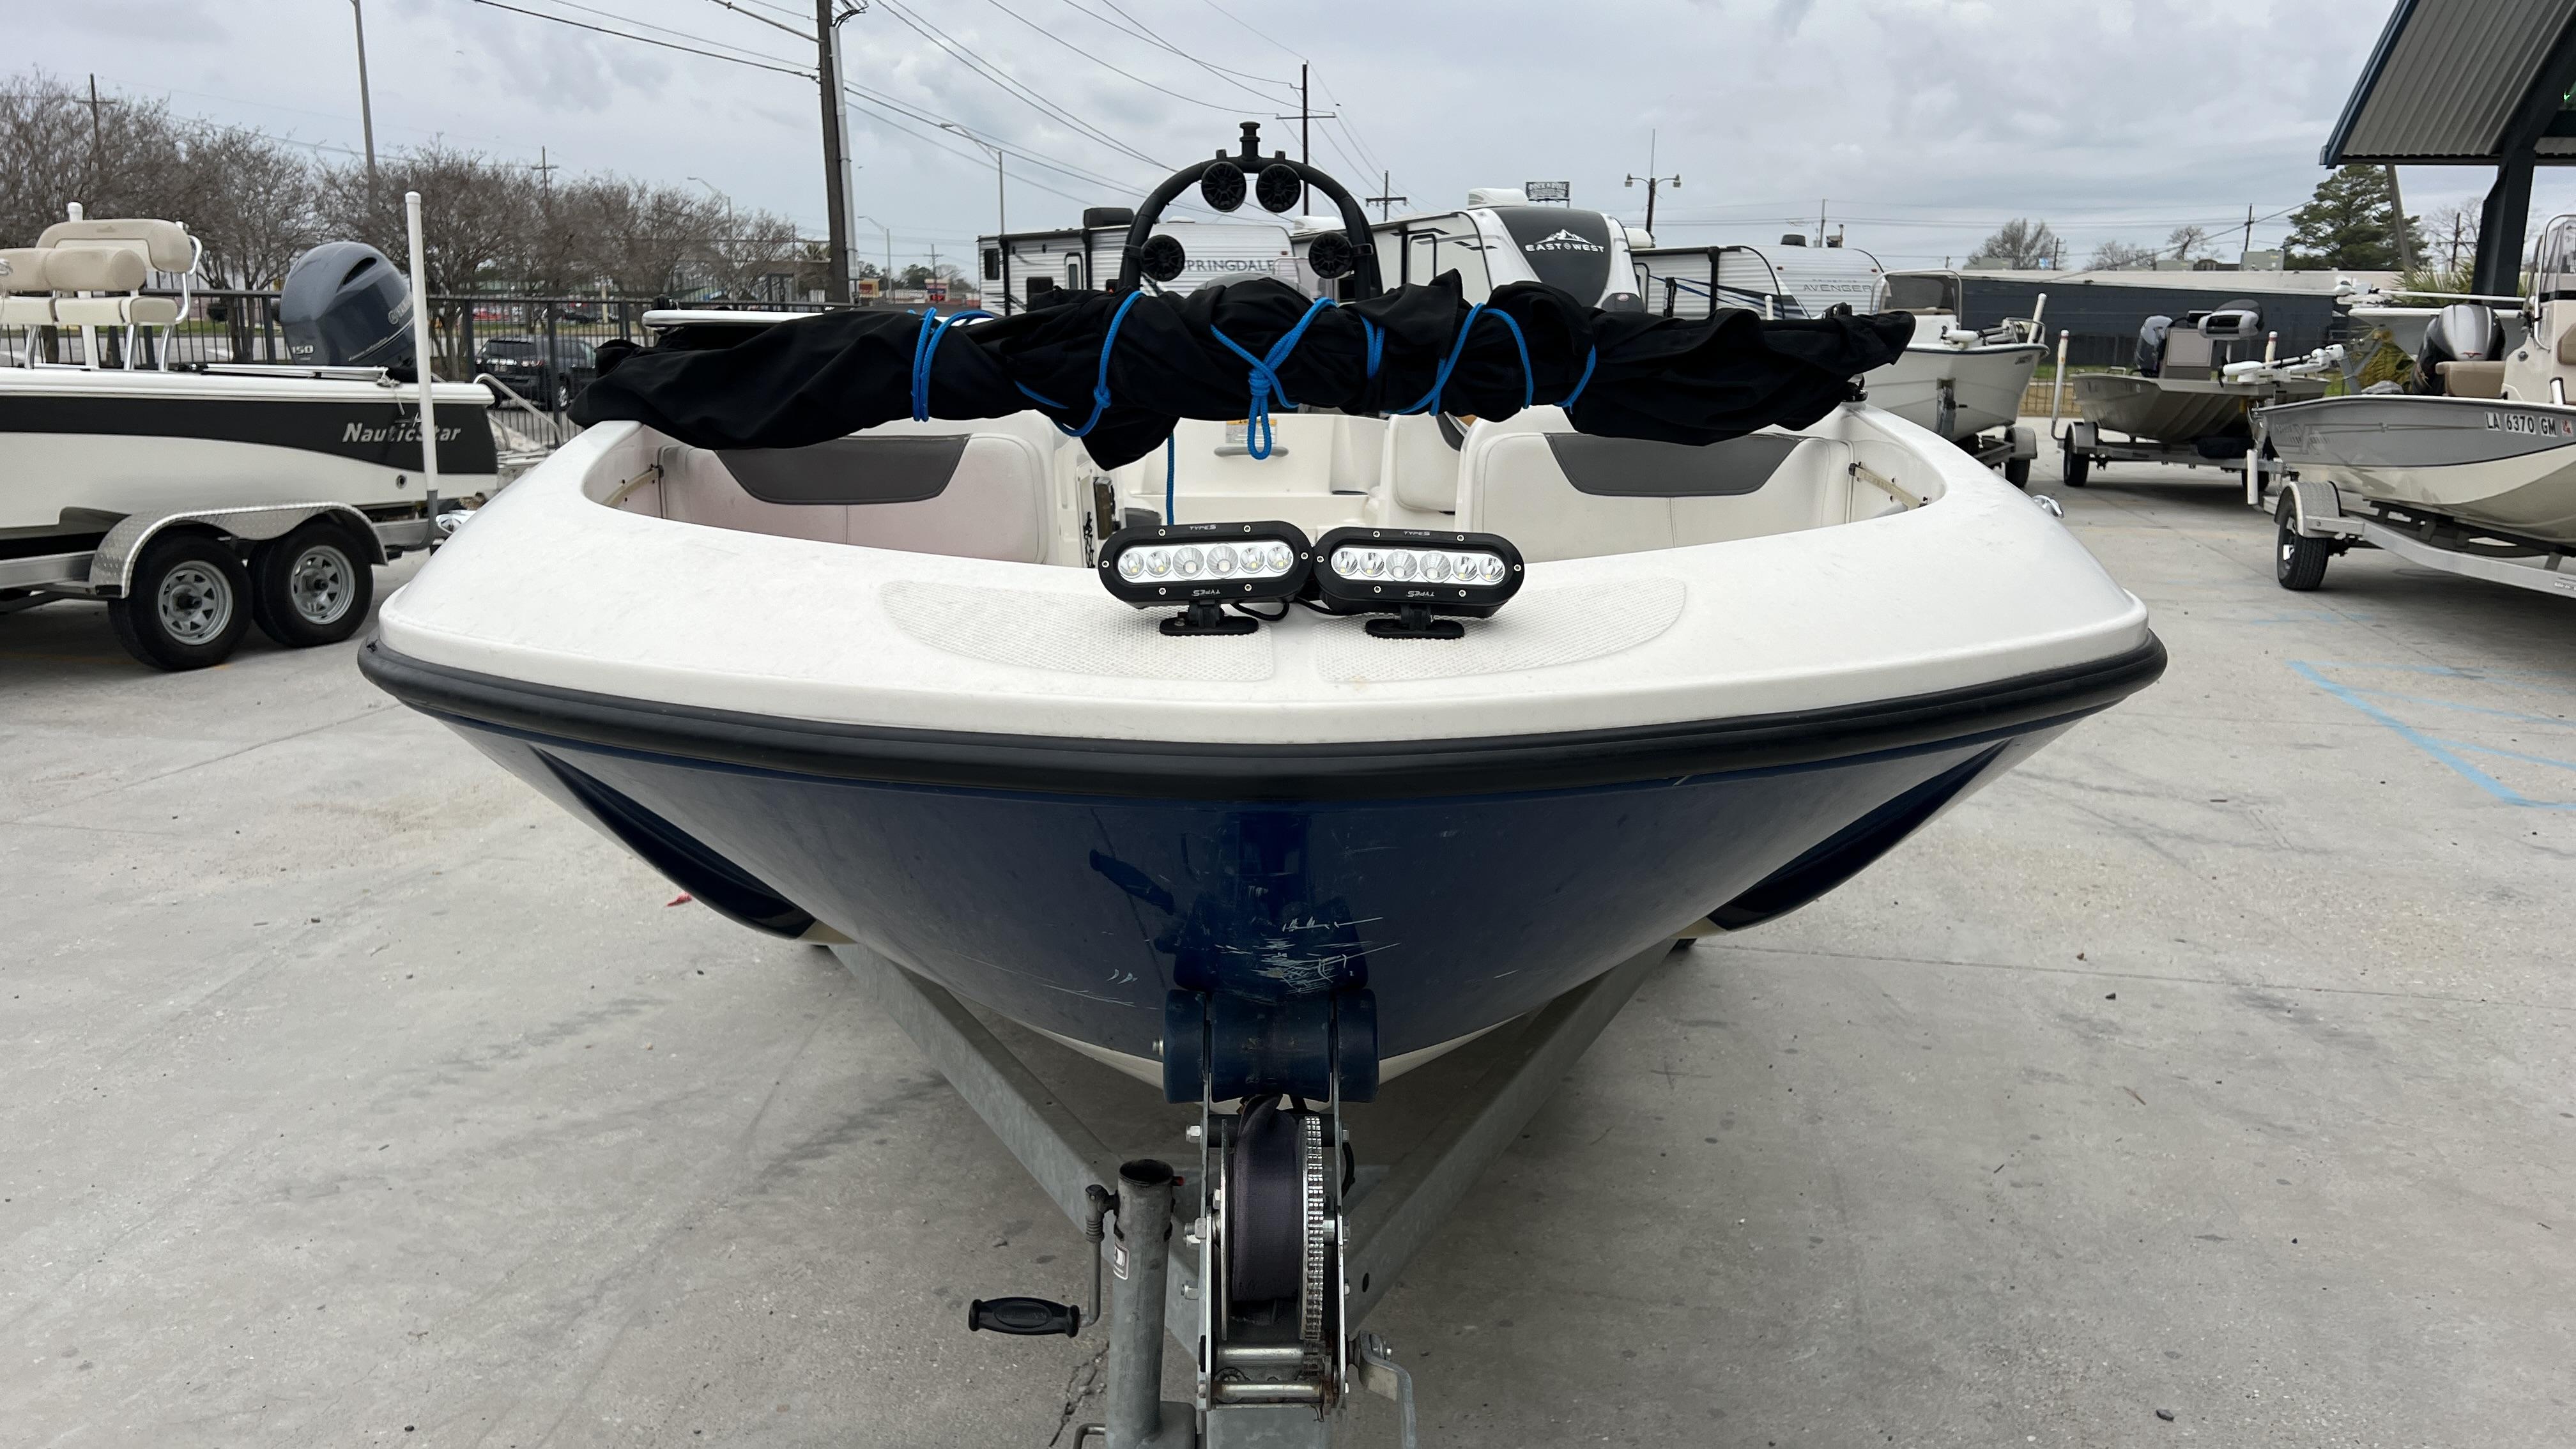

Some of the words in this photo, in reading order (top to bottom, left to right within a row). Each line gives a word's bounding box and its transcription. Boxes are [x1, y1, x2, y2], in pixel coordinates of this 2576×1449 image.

[1525, 243, 1561, 252] EAST
[1572, 243, 1604, 252] WEST
[1184, 259, 1275, 272] PRINGDALE
[1804, 284, 1873, 293] AVENGER
[292, 345, 314, 355] 150
[2486, 413, 2500, 429] LA
[2506, 415, 2534, 433] 6370
[2541, 418, 2557, 436] GM
